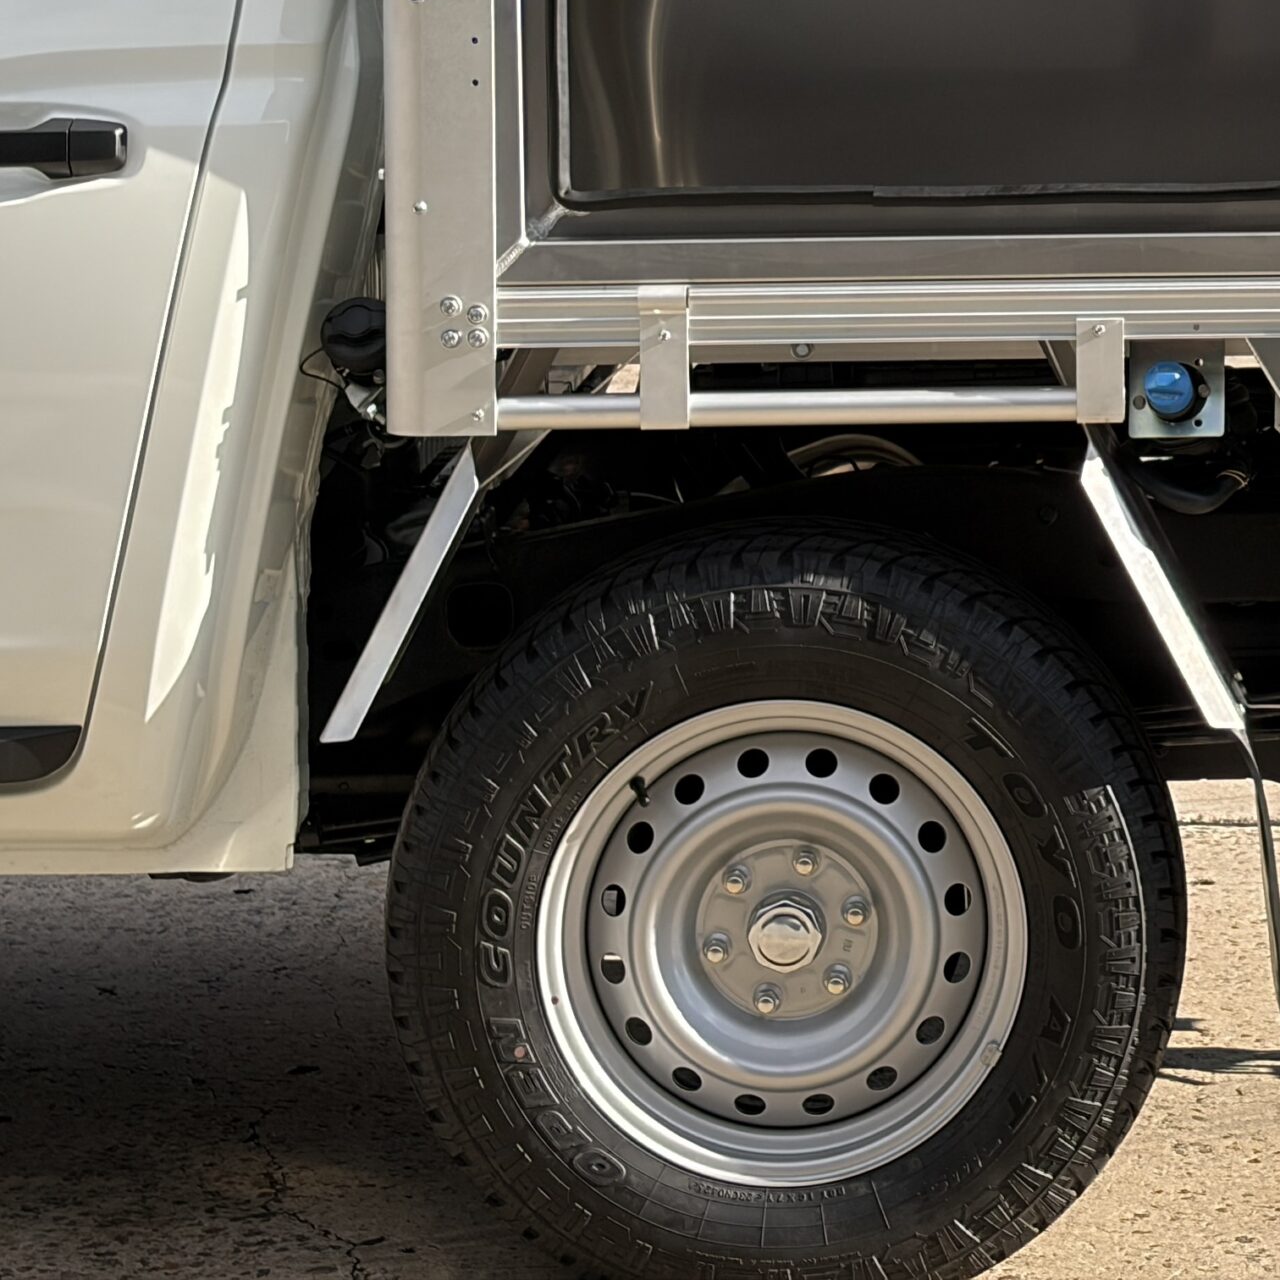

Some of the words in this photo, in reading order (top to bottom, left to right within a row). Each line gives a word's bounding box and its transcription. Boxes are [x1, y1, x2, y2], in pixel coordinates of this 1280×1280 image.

[479, 680, 654, 988] COUNTRY
[961, 716, 1082, 950] TOYO
[488, 1017, 626, 1184] OPEN
